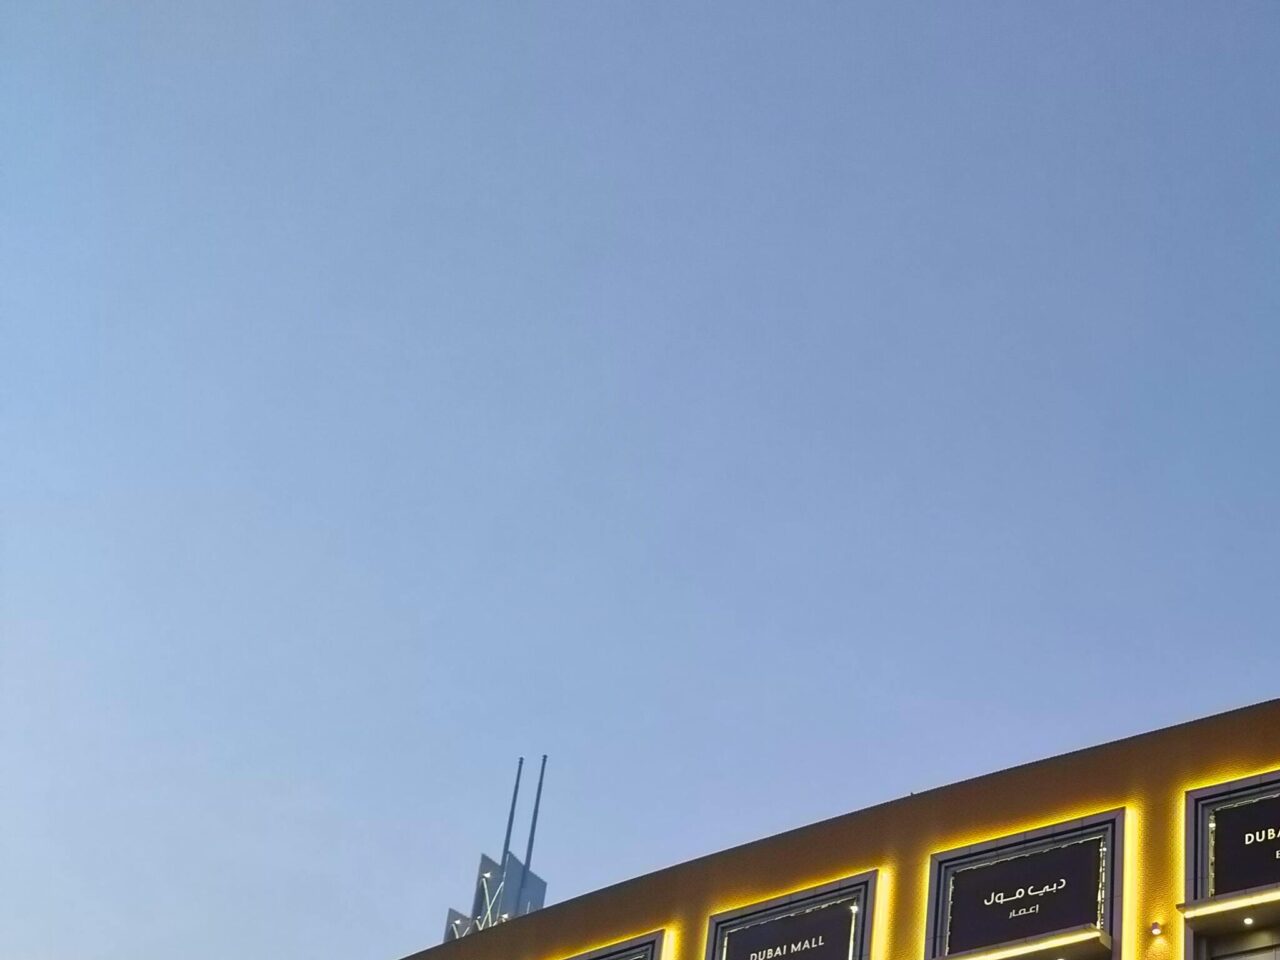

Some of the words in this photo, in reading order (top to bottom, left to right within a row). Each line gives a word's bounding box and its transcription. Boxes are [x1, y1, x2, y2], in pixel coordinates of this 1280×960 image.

[1027, 878, 1067, 896] دبي
[983, 888, 1025, 906] مول
[790, 935, 825, 954] MALL
